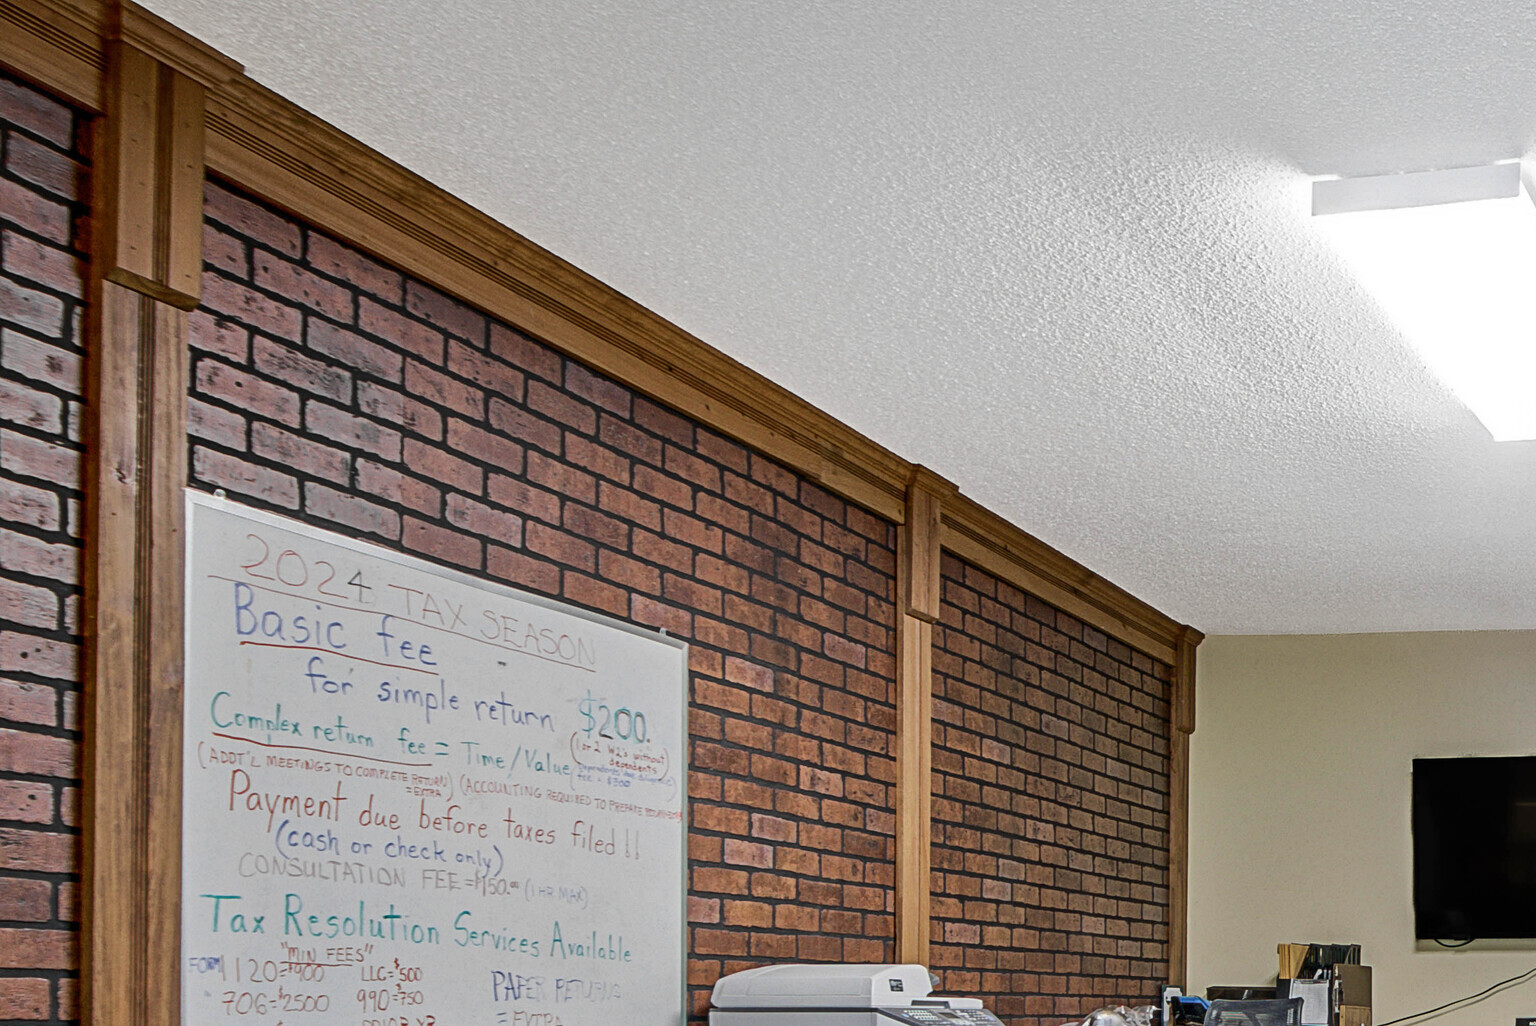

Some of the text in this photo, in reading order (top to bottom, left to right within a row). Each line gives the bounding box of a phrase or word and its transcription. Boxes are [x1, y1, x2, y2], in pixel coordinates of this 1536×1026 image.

[233, 581, 438, 667] Basic fee
[240, 533, 597, 666] 2024 TAX SEASON
[210, 691, 302, 746] Complex
[313, 715, 374, 748] return
[397, 727, 426, 755] fee
[304, 656, 354, 695] for
[376, 677, 460, 724] simple
[473, 691, 556, 733] return
[266, 754, 331, 772] MEETINGS
[336, 762, 352, 777] TO
[355, 765, 409, 783] COMPLETE
[546, 788, 592, 807] REQUIRED
[594, 797, 607, 811] TO
[229, 768, 348, 833] Payment
[359, 793, 401, 831] due
[419, 798, 488, 839] before
[503, 807, 556, 845] taxes
[570, 820, 616, 856] filed
[238, 851, 406, 888] CONSULTATION
[421, 868, 462, 891] FEE
[275, 819, 504, 879] (cash or check only)
[198, 893, 632, 963] Tax Resolution Services Available
